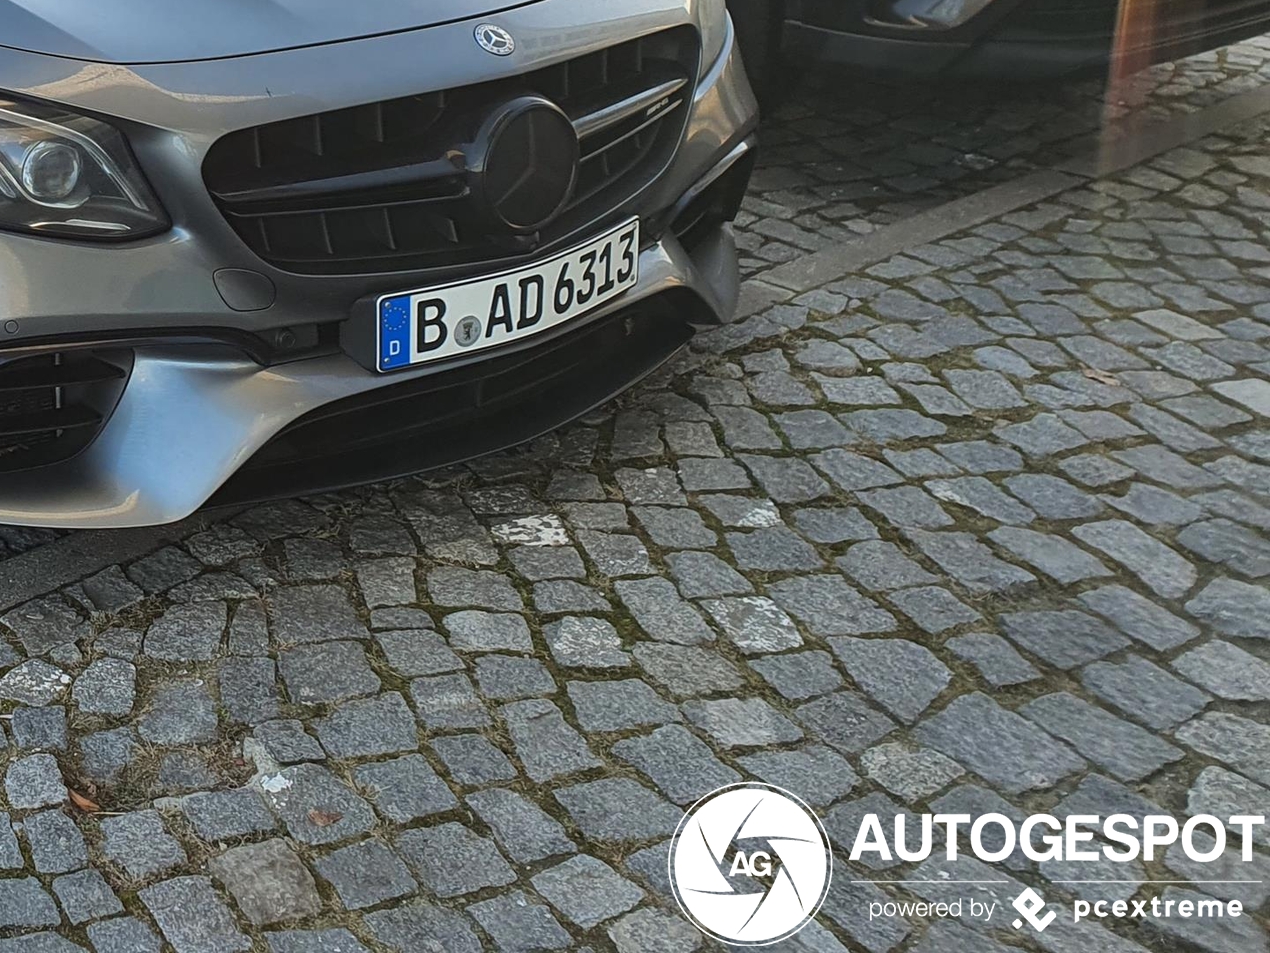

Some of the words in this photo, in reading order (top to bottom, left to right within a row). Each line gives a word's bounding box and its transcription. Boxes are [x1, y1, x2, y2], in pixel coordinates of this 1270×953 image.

[416, 298, 448, 354] B
[485, 274, 544, 338] AD
[554, 230, 635, 315] 6313
[389, 340, 400, 355] D
